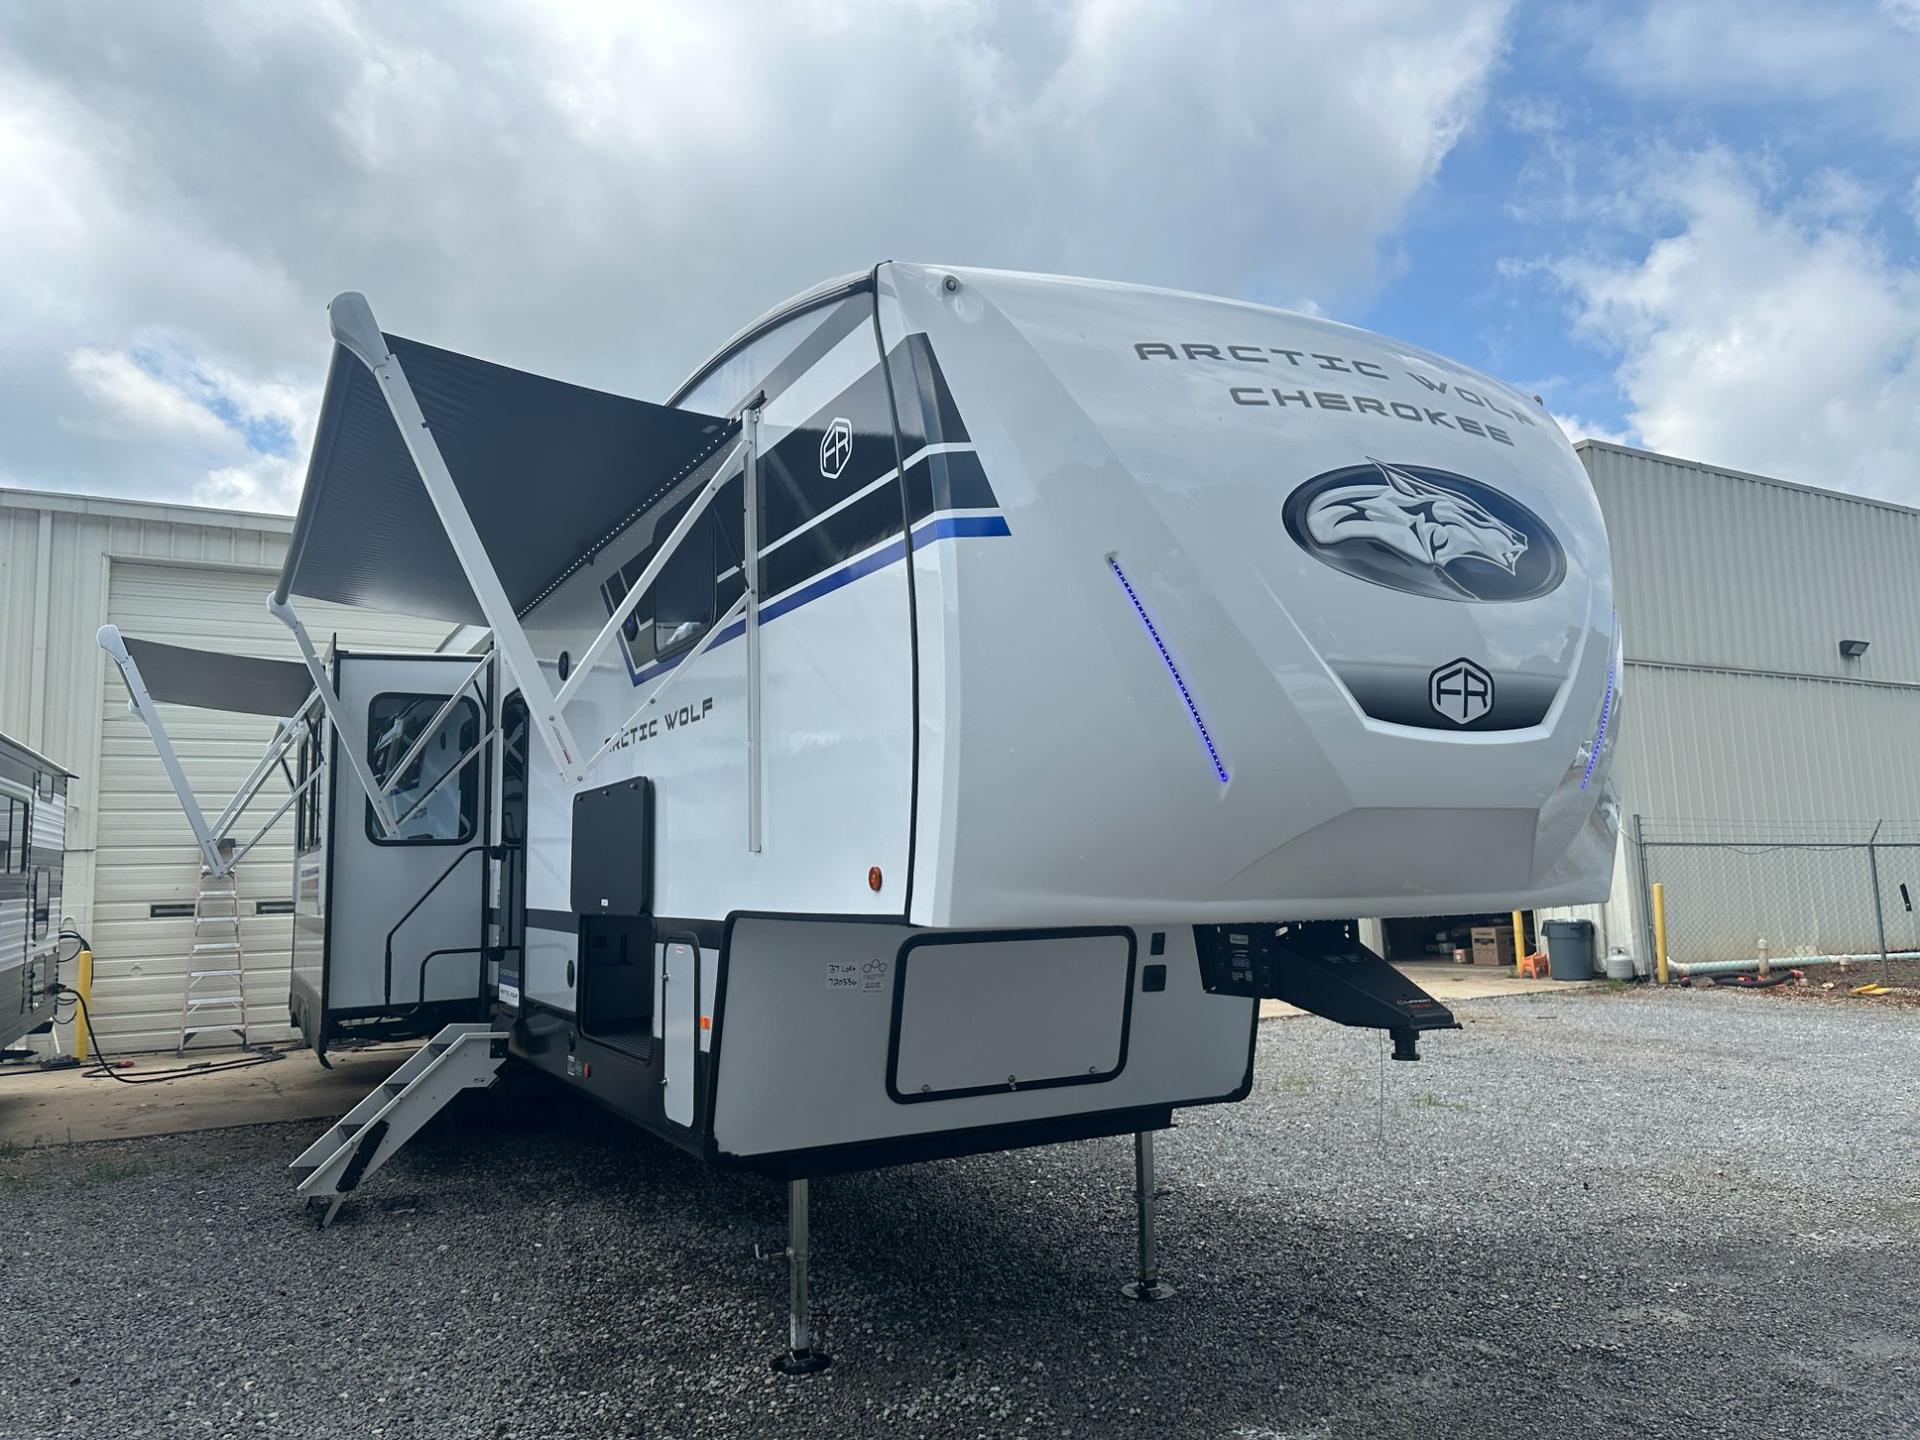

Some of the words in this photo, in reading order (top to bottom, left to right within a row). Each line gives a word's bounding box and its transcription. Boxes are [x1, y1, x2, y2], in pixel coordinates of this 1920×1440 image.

[1134, 343, 1390, 380] ARCTIC
[1406, 371, 1536, 427] WOLF
[1229, 387, 1515, 447] CHEROKEE
[664, 696, 713, 731] WOLF
